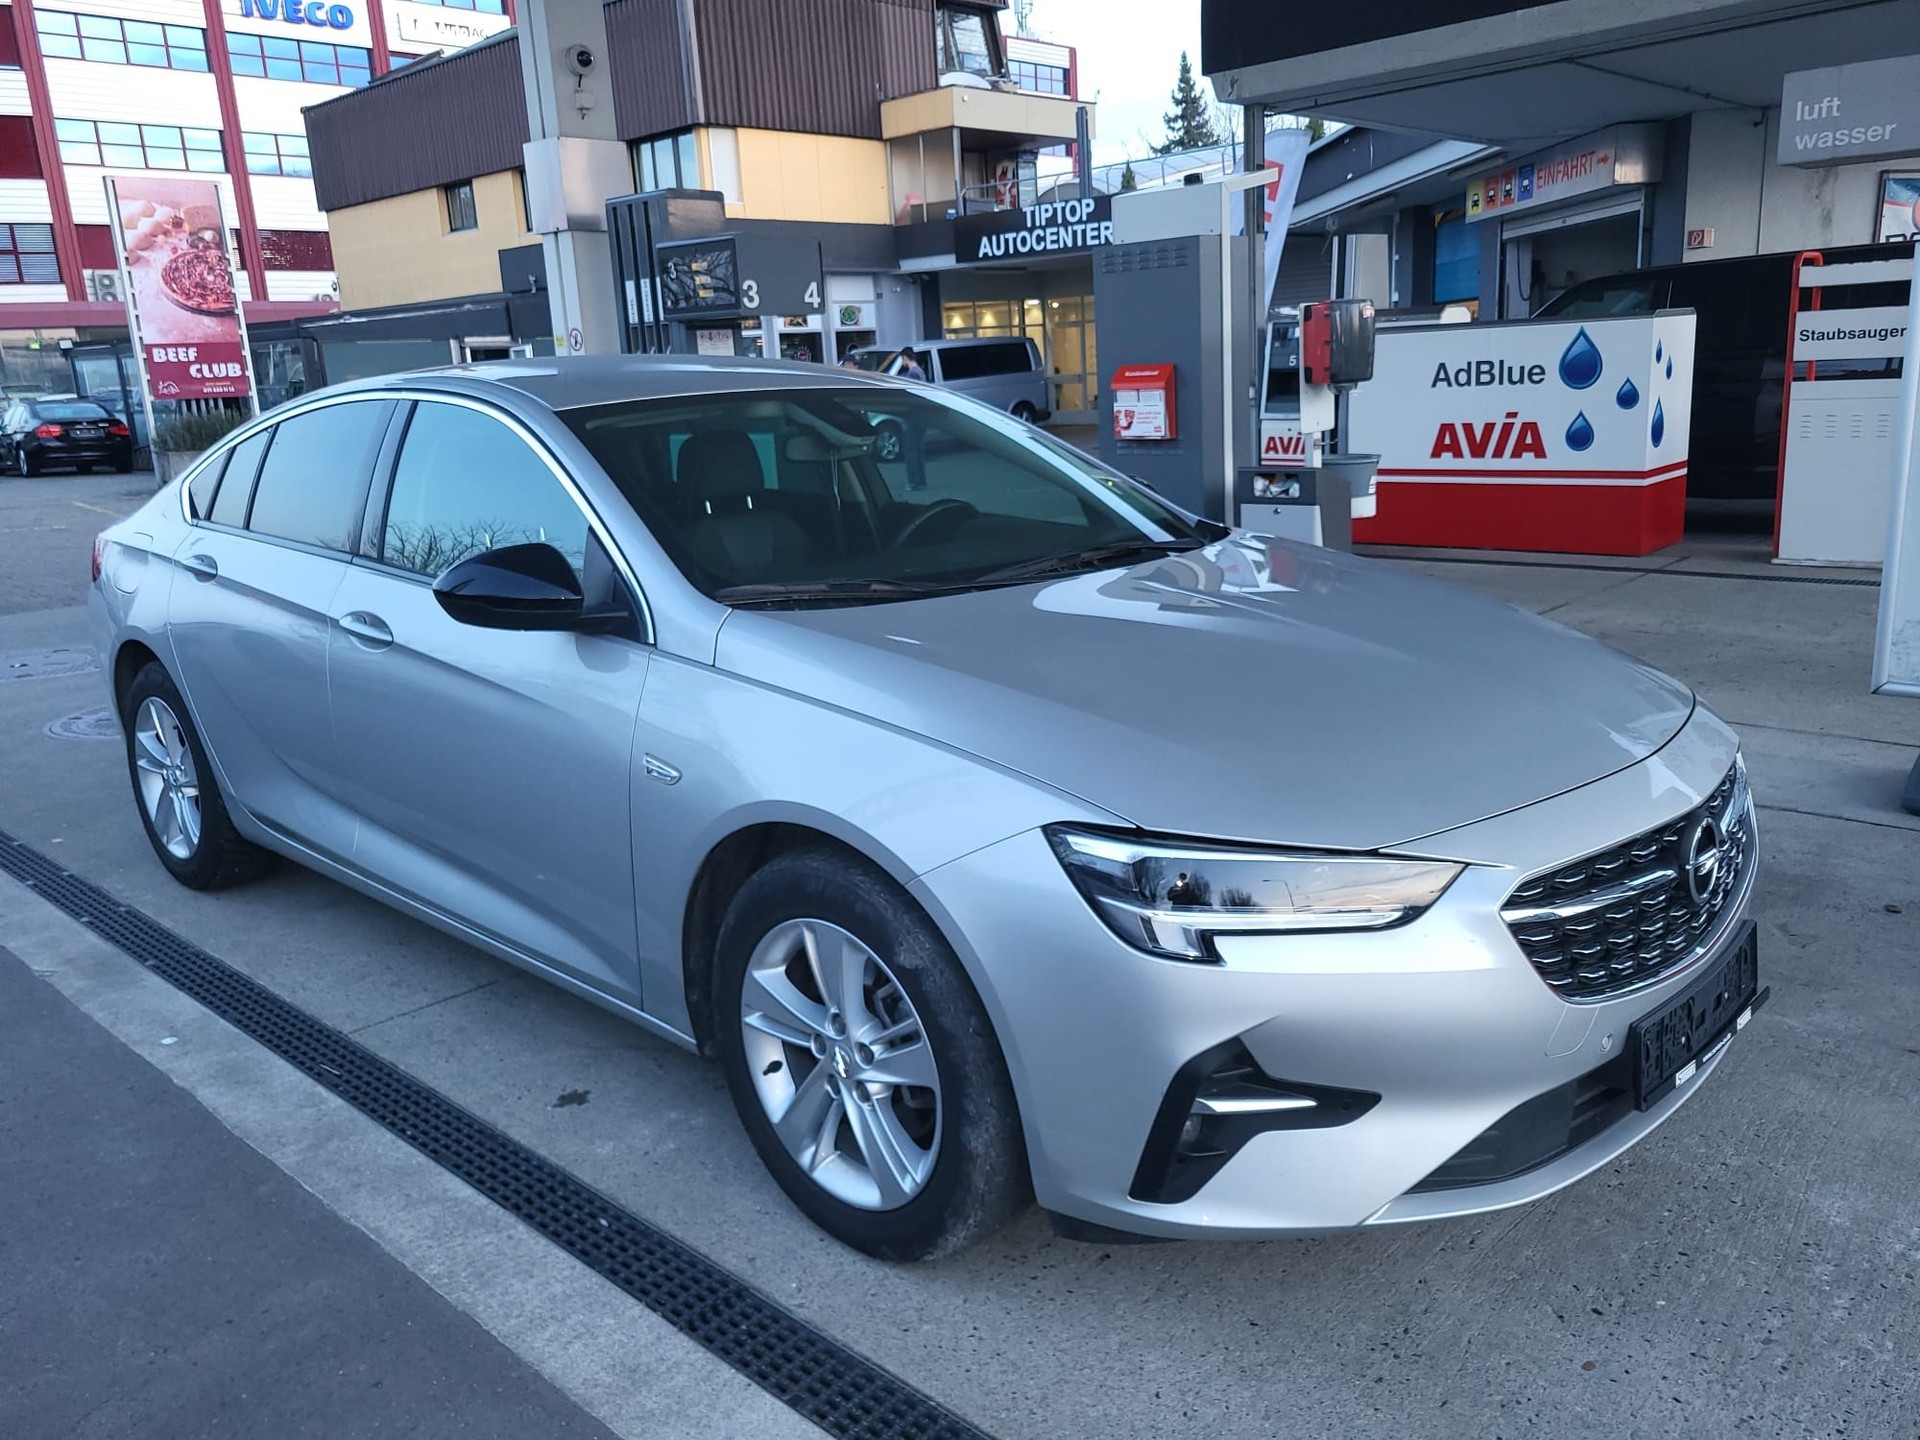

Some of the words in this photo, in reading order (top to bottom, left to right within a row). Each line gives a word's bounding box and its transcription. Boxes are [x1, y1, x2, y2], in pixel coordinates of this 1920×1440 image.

[241, 0, 354, 30] IVECO
[1796, 97, 1841, 122] luft
[1795, 123, 1897, 150] wasser
[1536, 150, 1596, 189] EINFAHRT
[1022, 199, 1095, 228] TIPTOP
[978, 221, 1114, 258] AUTOCENTER
[742, 280, 760, 309] 3
[803, 281, 821, 309] 4
[1799, 327, 1907, 342] Staubsauger
[152, 347, 198, 363] BEEF
[1288, 355, 1297, 366] 5
[189, 362, 242, 379] CLUB
[1431, 359, 1546, 388] AdBlue
